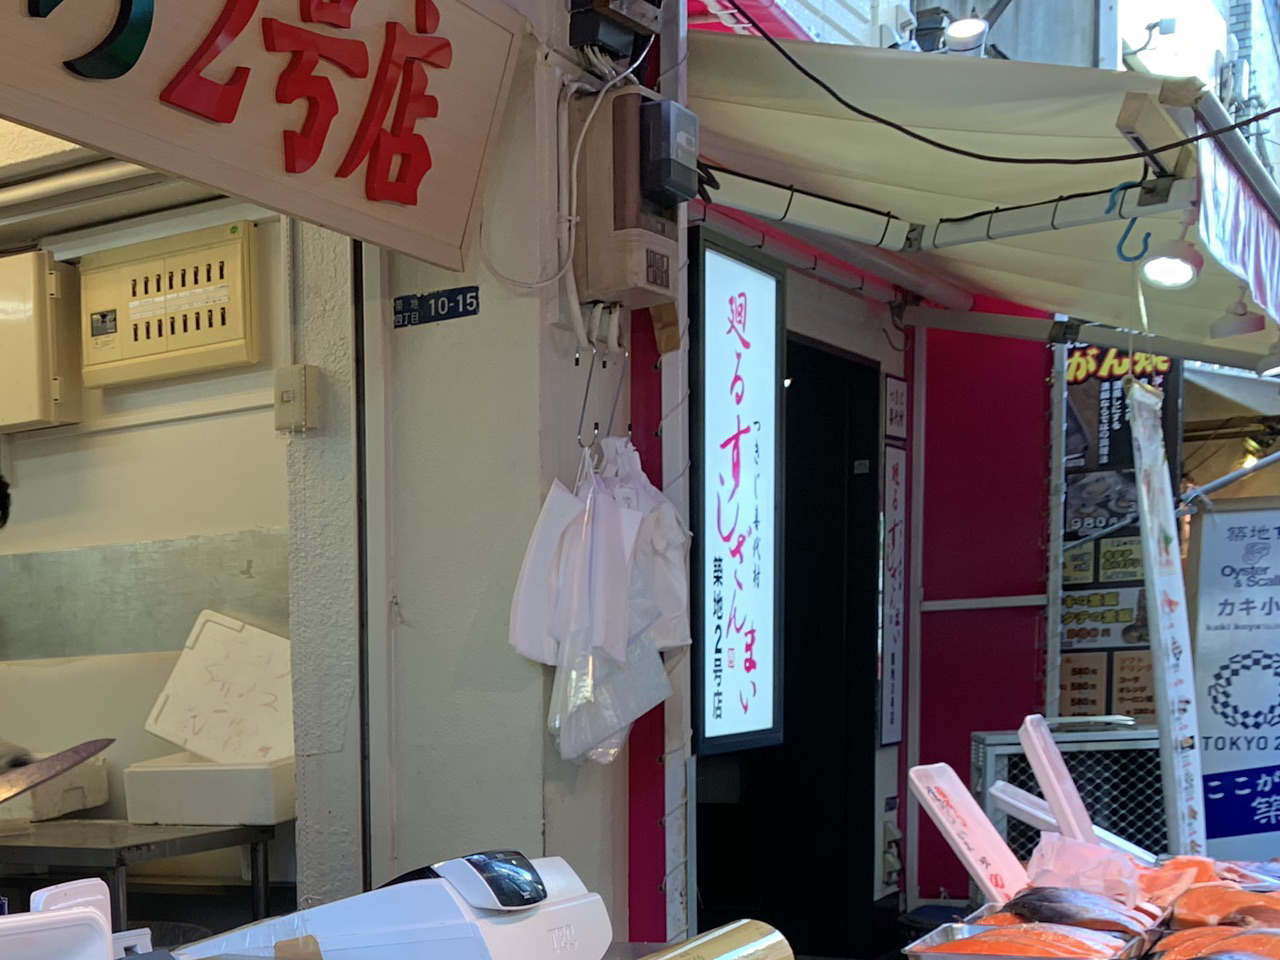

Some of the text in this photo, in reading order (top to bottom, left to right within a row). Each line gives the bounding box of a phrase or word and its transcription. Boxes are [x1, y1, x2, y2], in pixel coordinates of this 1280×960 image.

[429, 292, 477, 316] 10-15
[395, 312, 419, 326] 四丁目
[1221, 564, 1271, 580] Oyster
[1202, 736, 1269, 751] TOKYO
